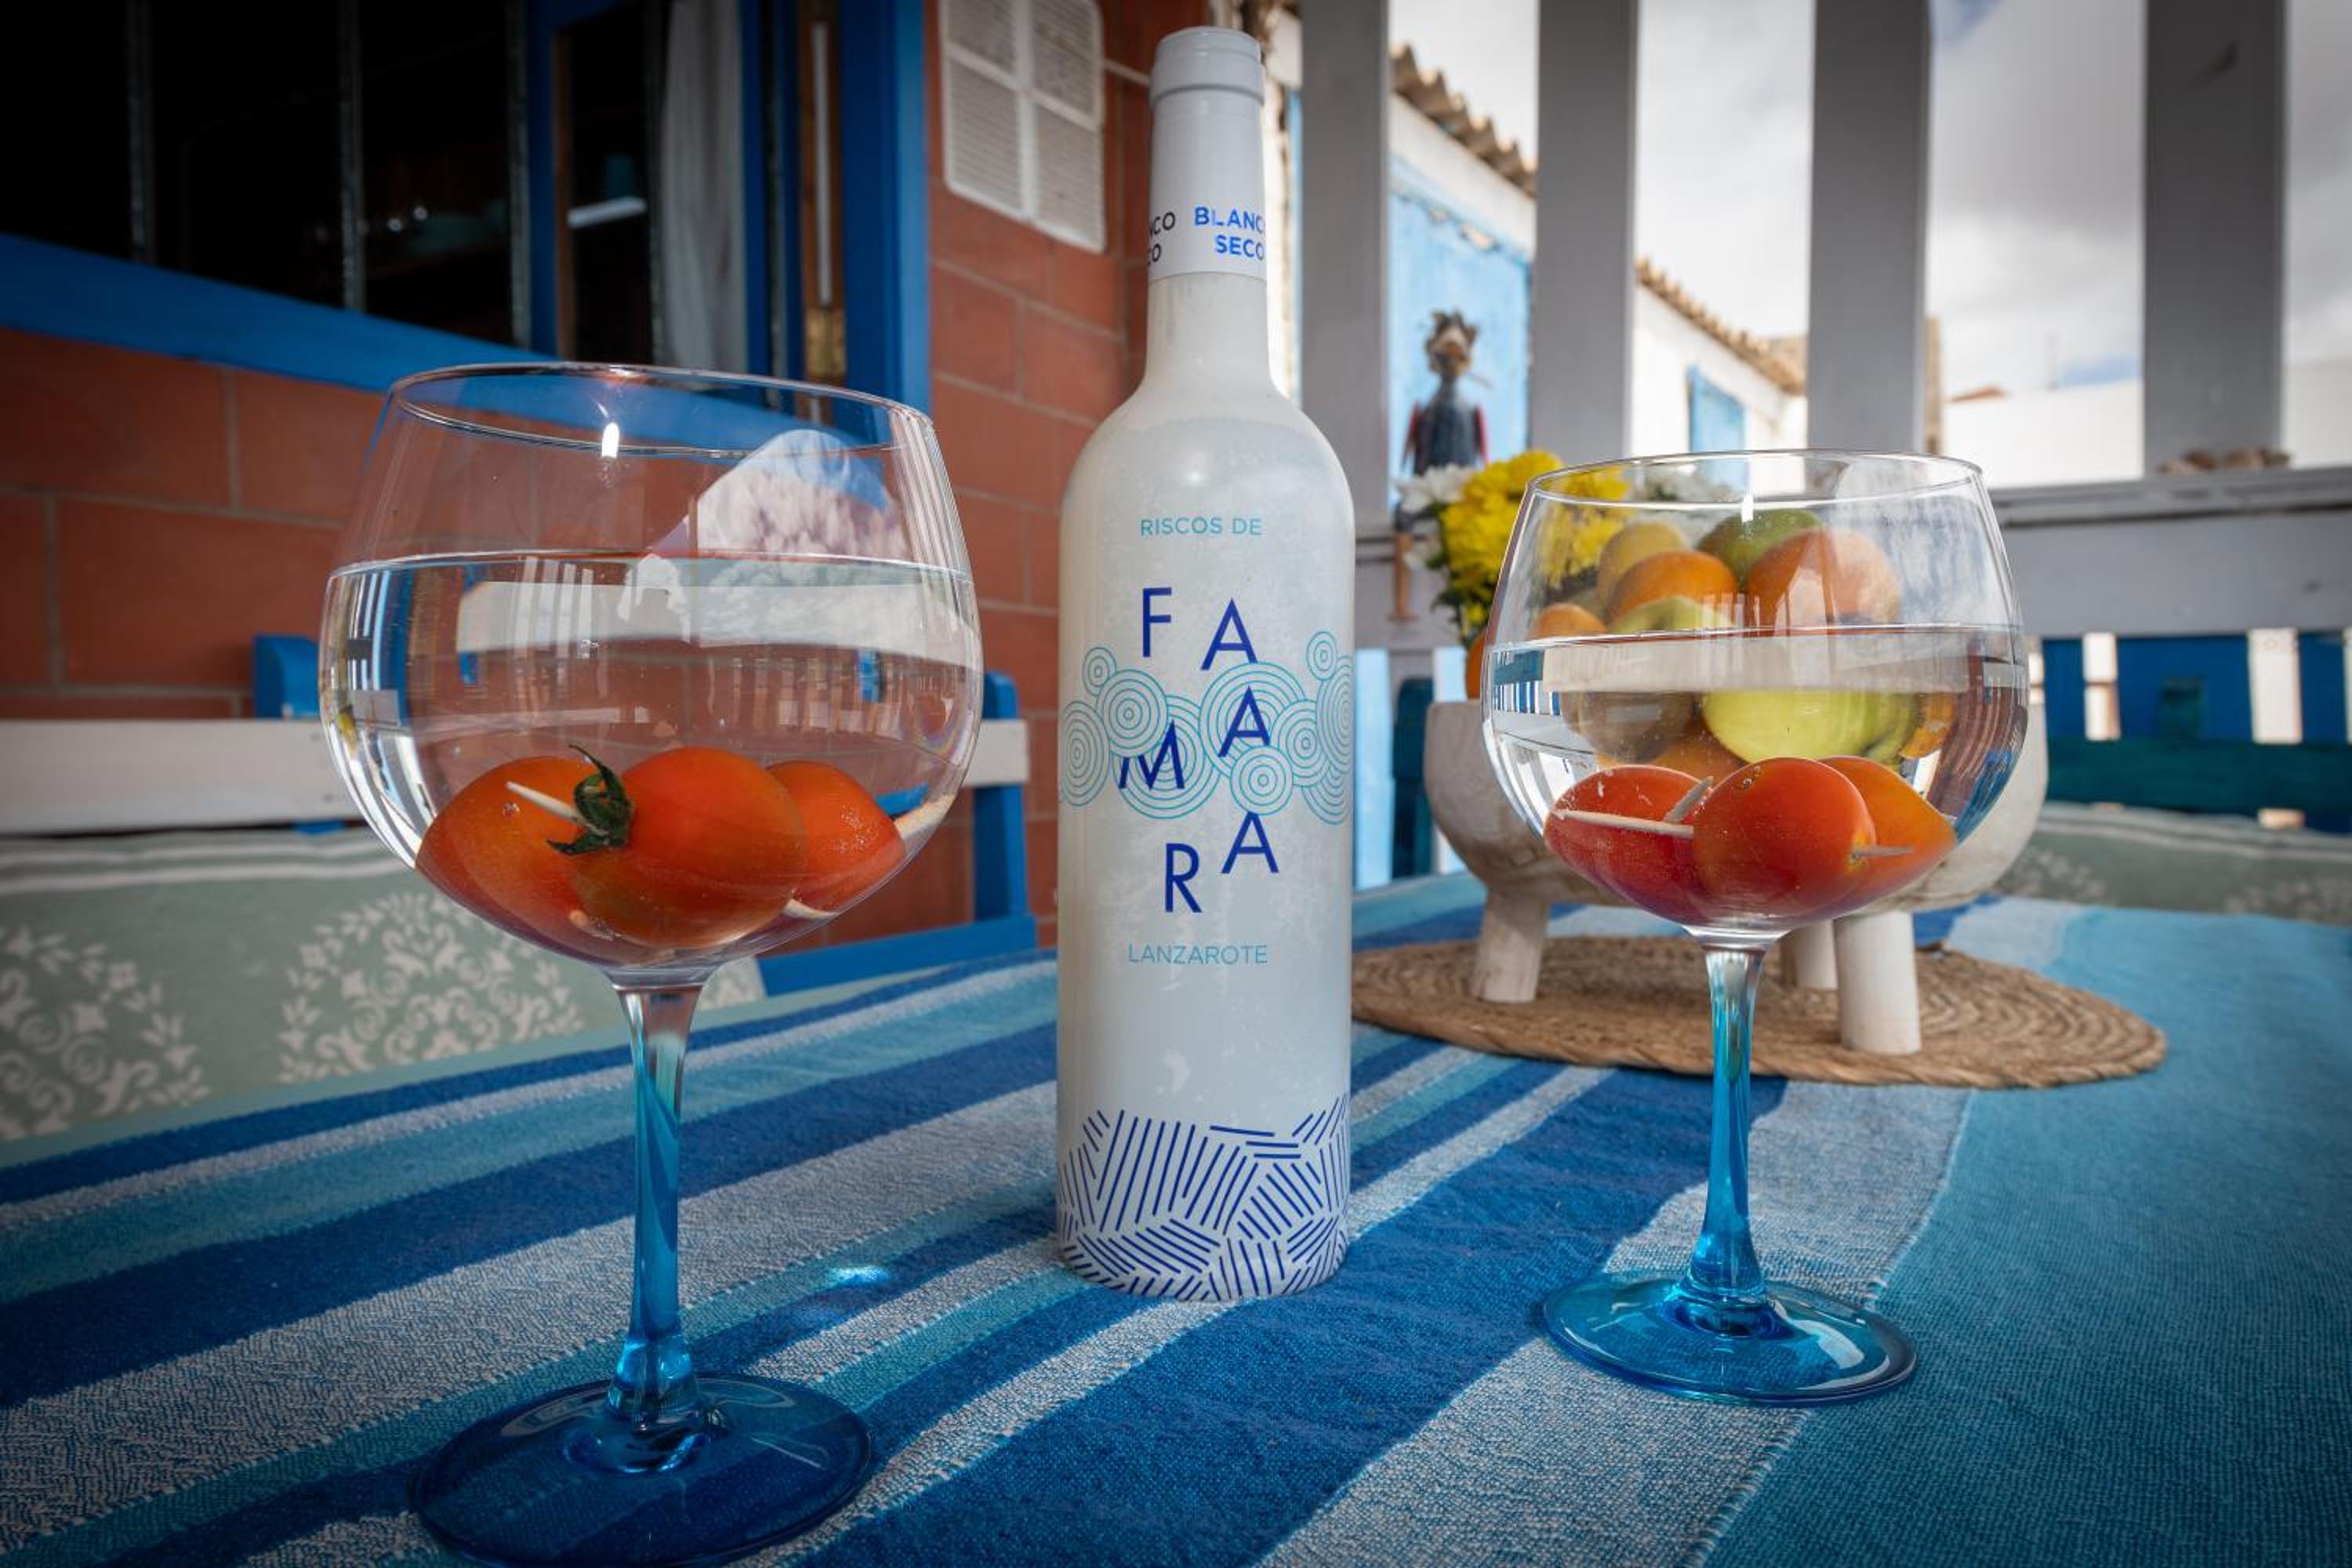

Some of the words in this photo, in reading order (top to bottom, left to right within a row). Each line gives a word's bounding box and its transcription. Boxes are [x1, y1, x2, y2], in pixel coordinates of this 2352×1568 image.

[1194, 206, 1265, 238] BLANC
[1215, 234, 1265, 261] SECO
[1141, 516, 1224, 536] RISCOS
[1232, 517, 1263, 535] DE
[1127, 943, 1269, 965] LANZAROTE
